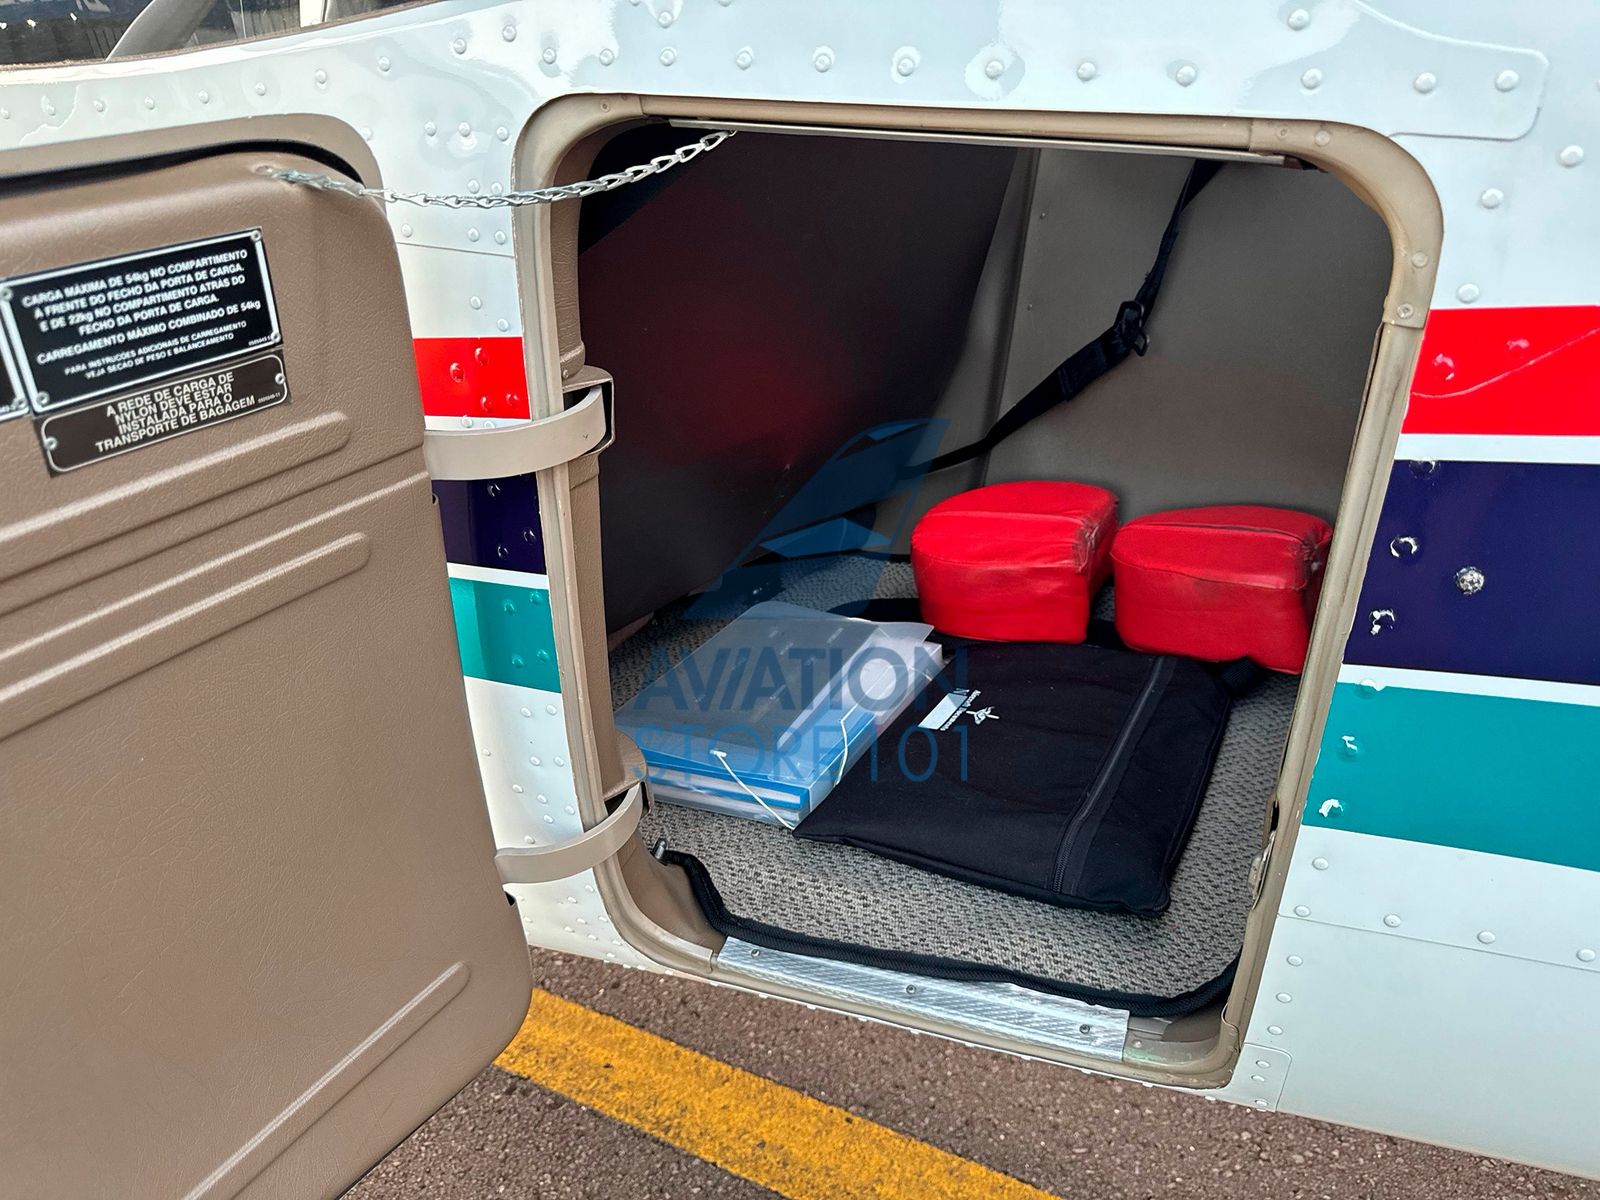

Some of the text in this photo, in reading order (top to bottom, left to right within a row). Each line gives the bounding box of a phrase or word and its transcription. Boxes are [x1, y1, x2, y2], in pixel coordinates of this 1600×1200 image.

[22, 289, 64, 308] CARGA
[108, 276, 123, 288] DE
[125, 272, 149, 285] 54kg
[150, 266, 166, 278] NO
[167, 249, 248, 274] COMPARTIMENTO
[40, 321, 49, 332] E
[50, 316, 66, 330] DE
[68, 312, 94, 326] 22kg
[94, 305, 111, 318] NO
[113, 286, 198, 314] COMPARTIMENTO
[231, 274, 245, 286] DO
[44, 297, 88, 317] FRENTE
[88, 293, 106, 306] DO
[107, 285, 143, 301] FECHO
[144, 281, 160, 294] DA
[160, 274, 194, 290] PORTA
[194, 270, 208, 281] DE
[209, 262, 245, 278] CARGA.
[36, 300, 261, 365] CARREGAMENTO MÁXIMO COMBINADO DE 54kg
[79, 293, 220, 337] FECHO DA PORTA DE CARGA.
[64, 364, 87, 375] PARA
[137, 338, 179, 356] ADICIONAIS
[180, 335, 190, 344] DE
[190, 320, 247, 341] CARREGAMENTO
[85, 368, 106, 379] VEJA
[134, 357, 145, 366] DE
[146, 351, 167, 363] PESO
[167, 349, 173, 357] E
[173, 332, 234, 355] BALANCEAMENTO
[106, 371, 235, 417] A REDE DE CARGA DE
[114, 383, 233, 425] NYLON DEVE ESTAR
[118, 393, 233, 435] INSTALADA PARA O
[95, 419, 179, 453] TRANSPORTE
[180, 414, 198, 427] DE
[199, 395, 255, 421] BAGAGEM
